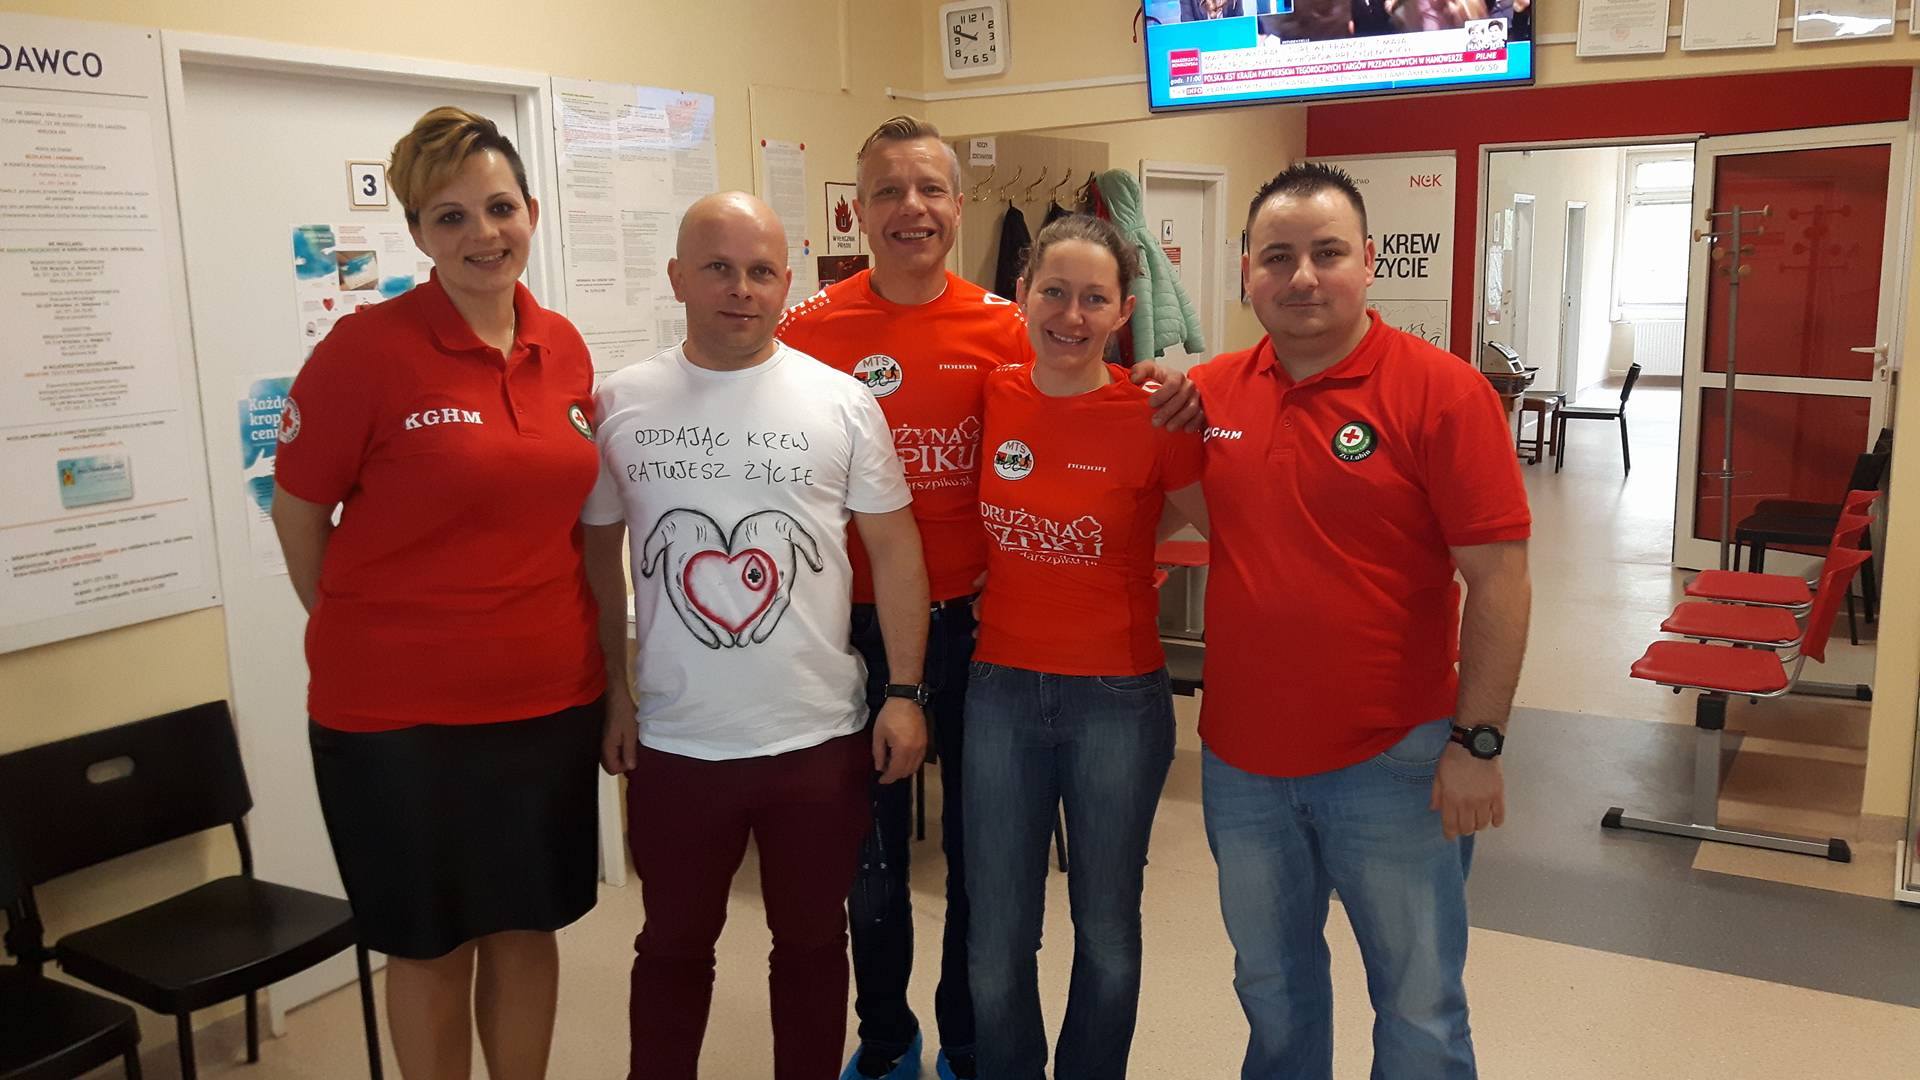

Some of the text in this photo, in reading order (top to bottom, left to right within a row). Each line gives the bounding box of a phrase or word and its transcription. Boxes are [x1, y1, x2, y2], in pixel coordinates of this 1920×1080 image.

[1475, 51, 1497, 60] PILNE
[1203, 74, 1224, 83] POLSKA
[1224, 73, 1236, 81] JEST
[1236, 71, 1257, 81] KRAJEM
[1296, 64, 1341, 76] TEGOROCZNYCH
[1341, 60, 1367, 71] TARGÓW
[1425, 54, 1463, 65] HANOWERZE
[362, 174, 377, 197] 3
[1165, 225, 1171, 236] 4
[1382, 233, 1441, 254] KREW
[1374, 253, 1429, 278] ŻYCIE
[863, 356, 890, 368] MTS
[250, 410, 284, 427] krop
[405, 408, 484, 430] KGHM
[635, 426, 810, 456] ODDAJĄC KREW
[1005, 441, 1026, 454] MTS
[745, 459, 815, 485] ŻYCIE
[980, 501, 1078, 540] DRUŻYNA
